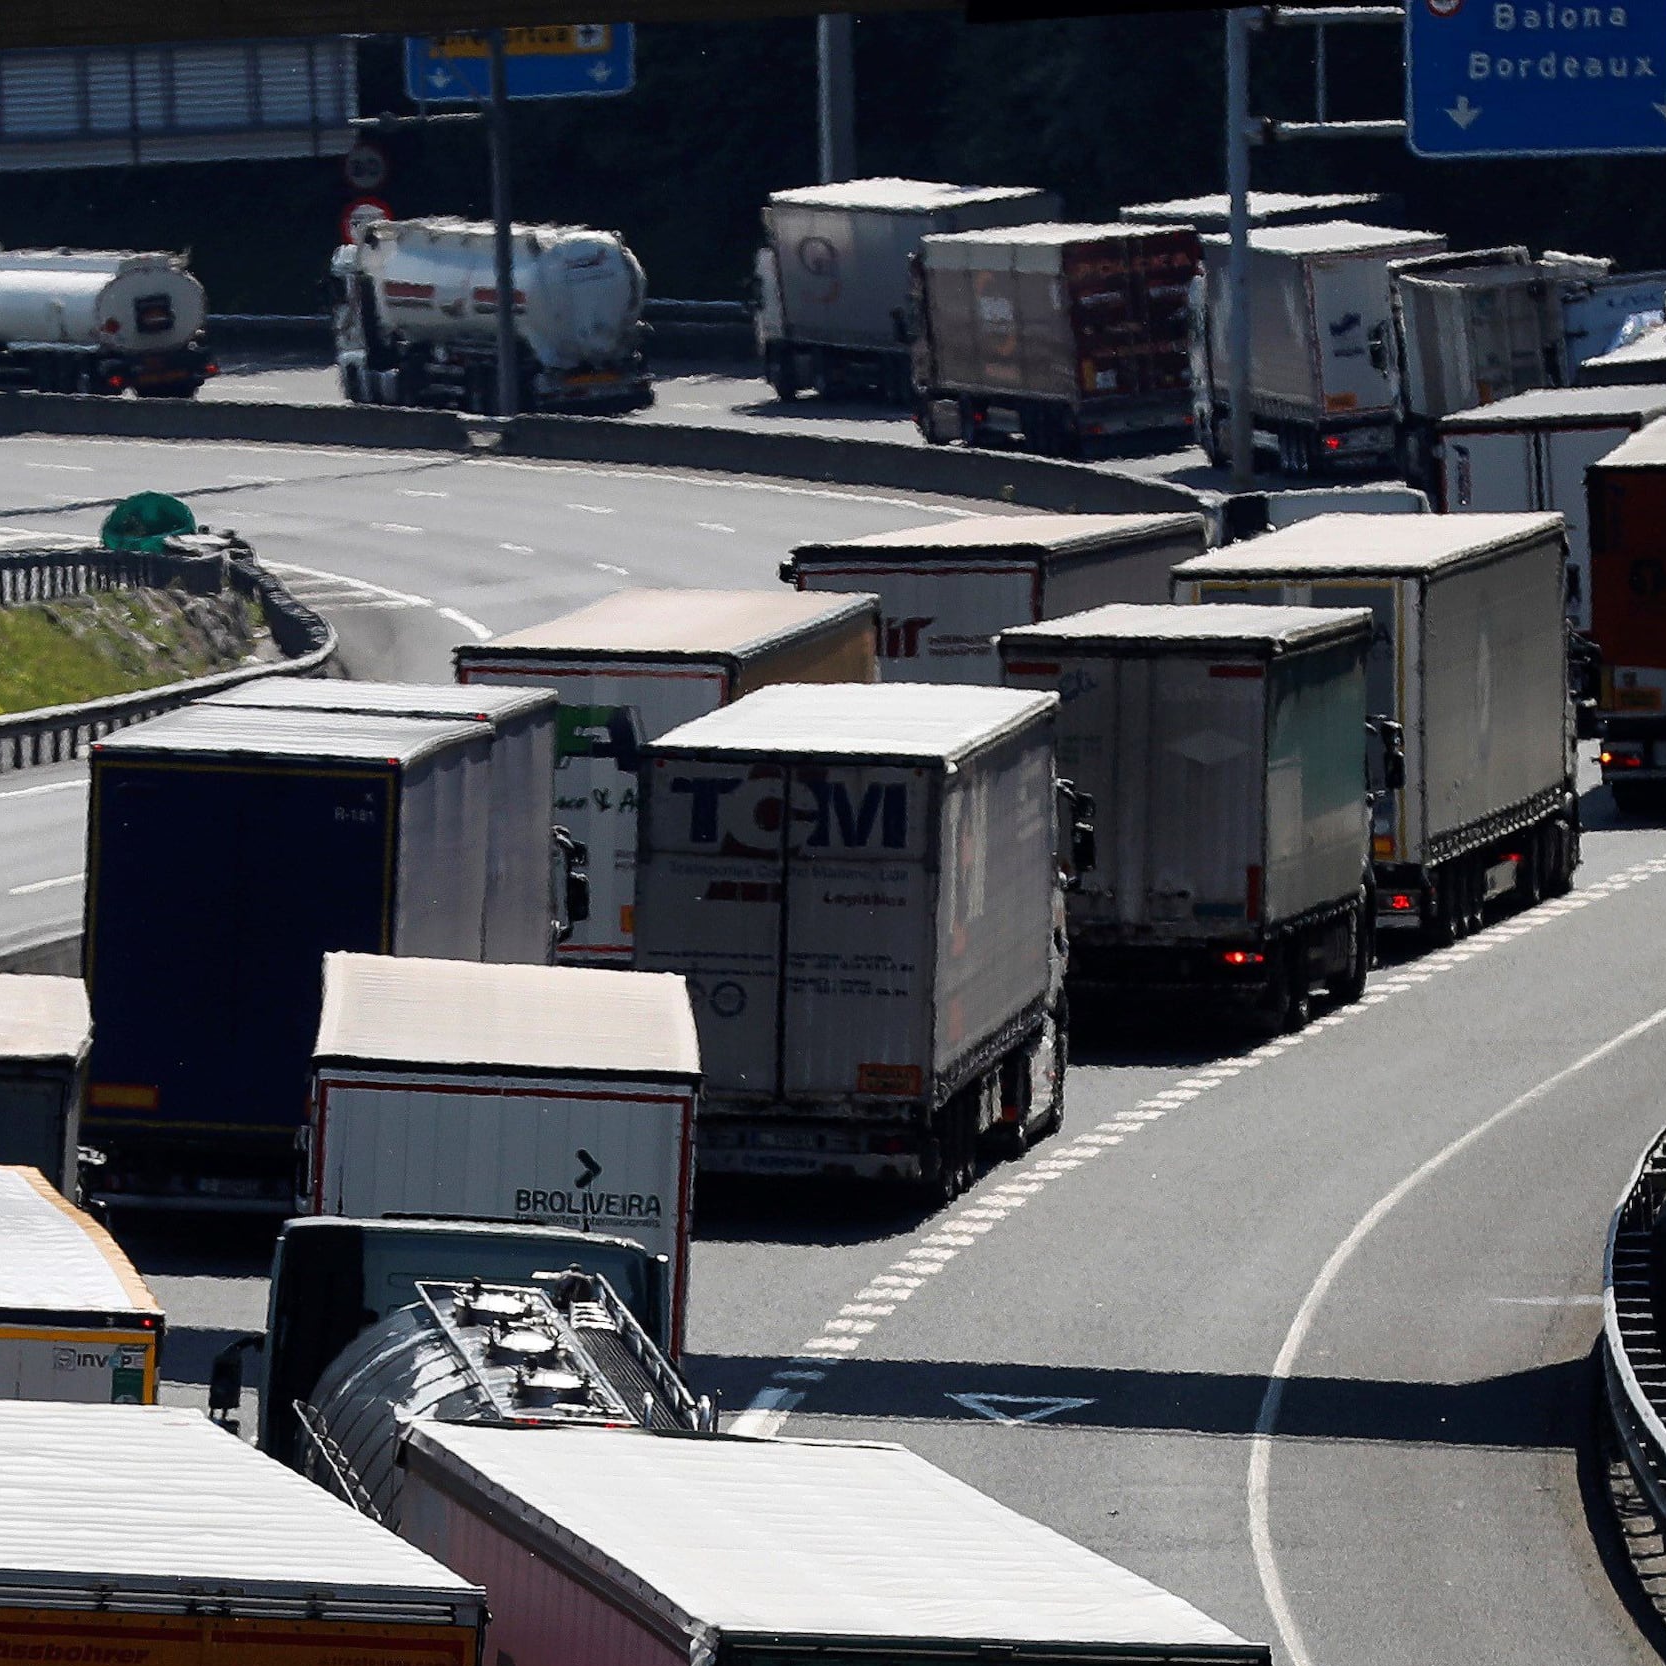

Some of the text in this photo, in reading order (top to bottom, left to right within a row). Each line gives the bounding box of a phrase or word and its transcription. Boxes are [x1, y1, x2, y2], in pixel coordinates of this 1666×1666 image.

[1494, 2, 1627, 31] Baiona
[1469, 51, 1657, 80] Bordeaux
[516, 1188, 662, 1218] BROLIVEIRA
